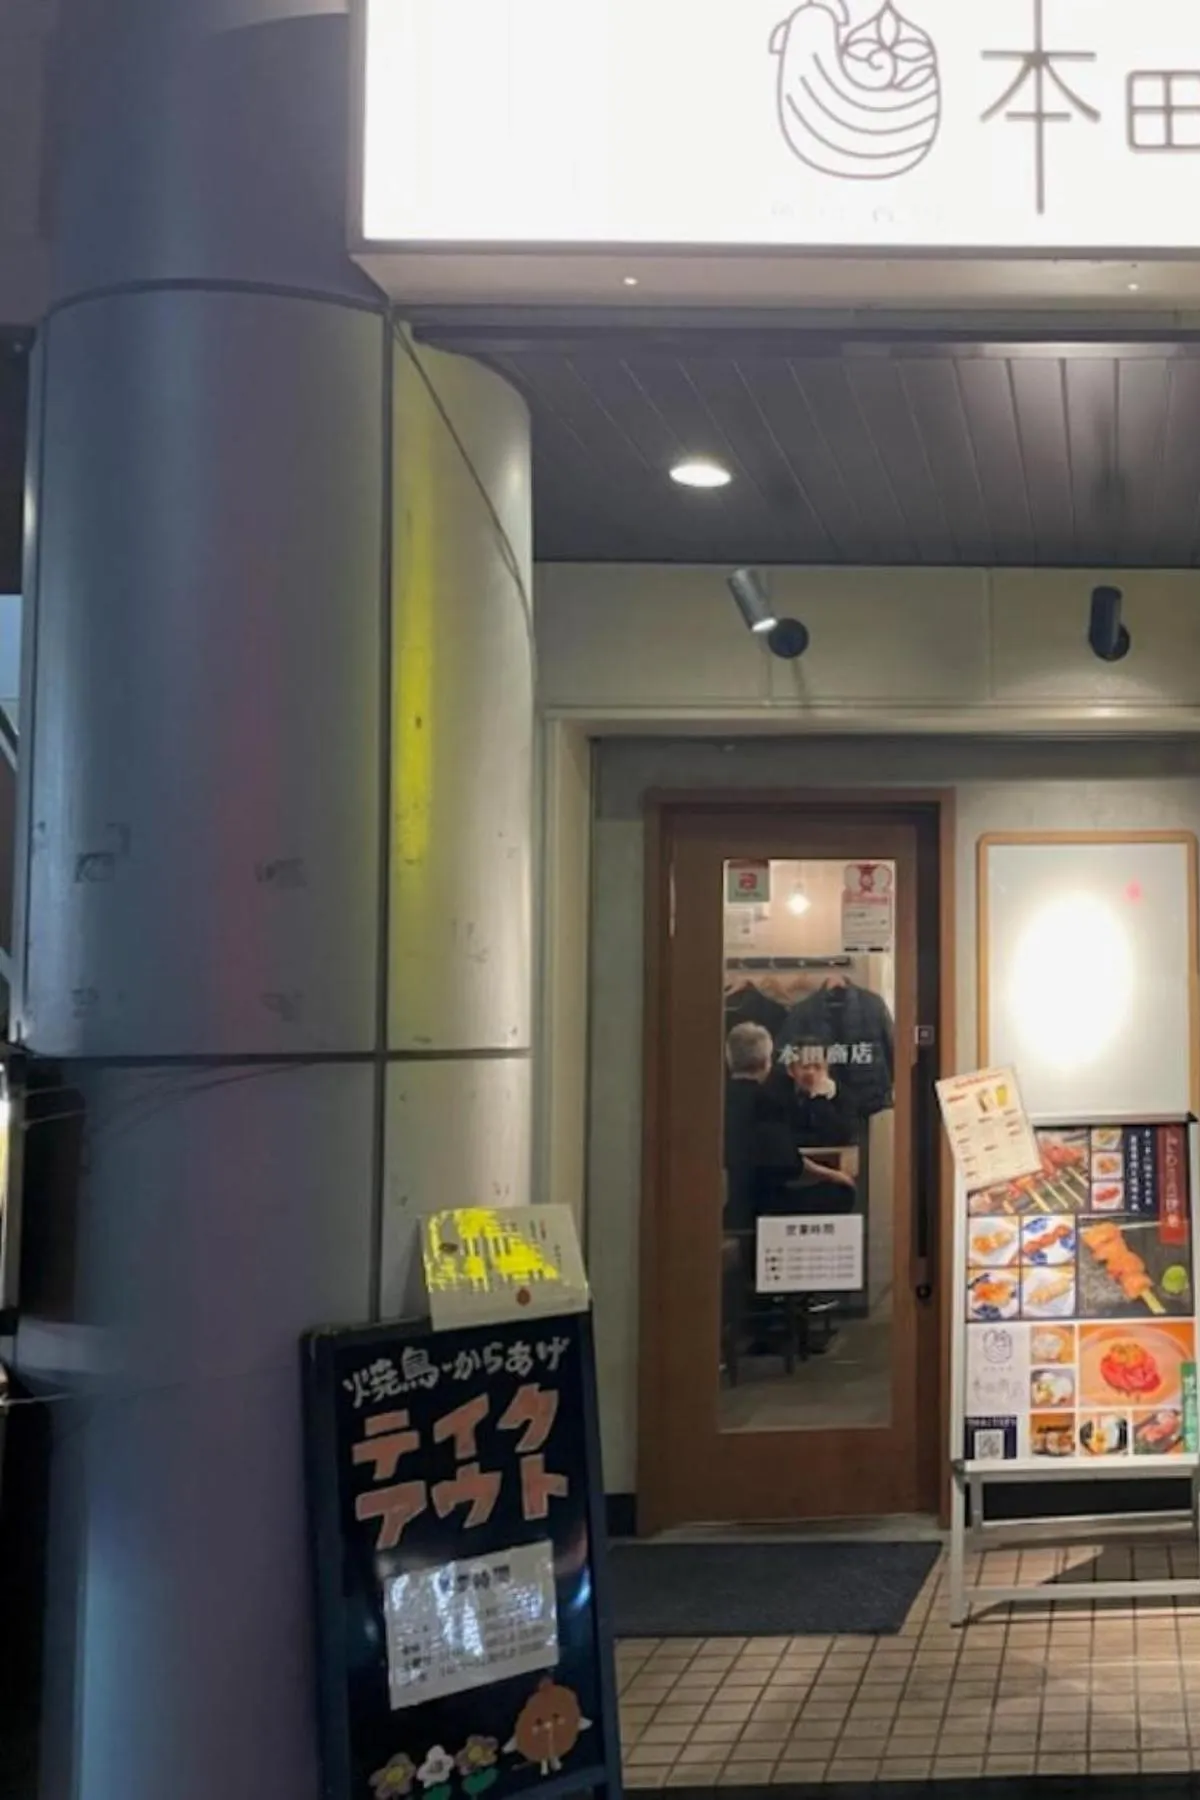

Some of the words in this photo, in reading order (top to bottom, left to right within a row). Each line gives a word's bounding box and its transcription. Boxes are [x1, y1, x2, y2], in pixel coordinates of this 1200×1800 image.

[352, 1383, 559, 1481] テイク
[355, 1453, 568, 1550] アウト
